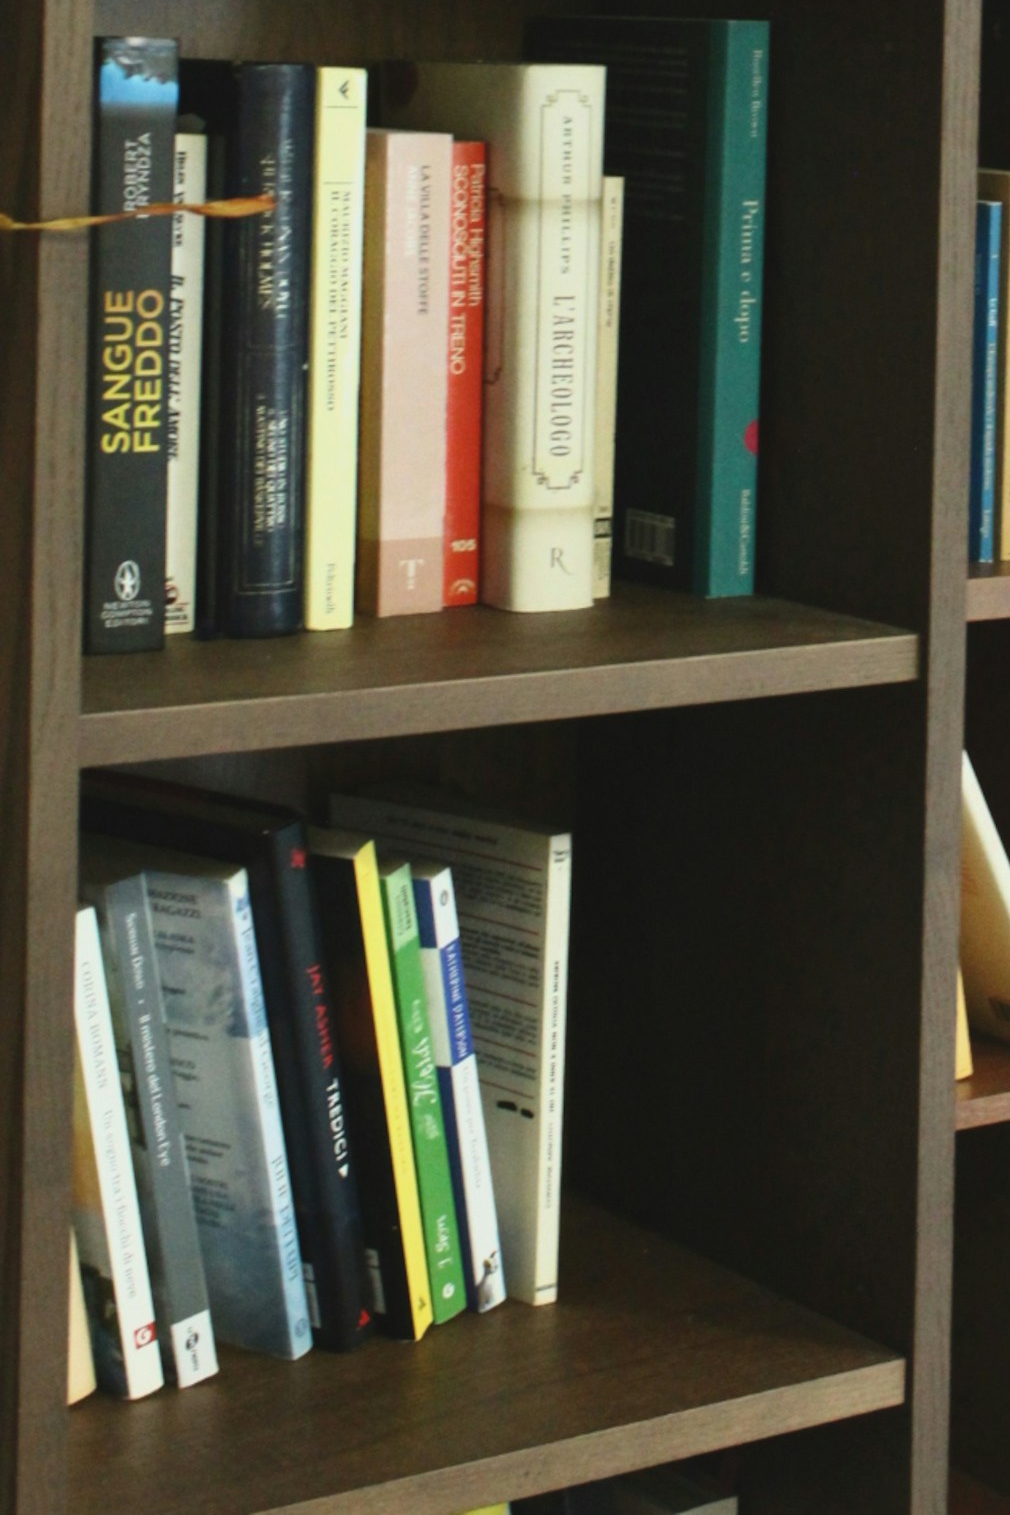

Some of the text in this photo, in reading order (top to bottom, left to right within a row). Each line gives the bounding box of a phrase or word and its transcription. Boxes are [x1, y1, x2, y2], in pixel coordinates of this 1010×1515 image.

[749, 99, 761, 138] Brown
[119, 139, 141, 210] ROBERT
[418, 185, 431, 221] VILLA
[558, 116, 575, 275] ARTHUR PHILLIPS
[328, 206, 341, 284] CORAGGIO
[338, 190, 353, 340] MAURIZIO MAGGIANI
[417, 223, 431, 264] DELLE
[464, 163, 486, 308] Patricia Highsmith
[738, 196, 761, 263] Prima
[327, 288, 338, 315] DEL
[416, 267, 431, 315] STOFFE
[447, 165, 474, 376] SCONOSCIUTI IN TRENO
[733, 288, 758, 343] dopo
[101, 290, 135, 454] SANGUE
[131, 289, 164, 454] FREDDO
[324, 319, 337, 412] PETTIROSSO
[547, 294, 578, 457] L'ARCHEOLOGO
[451, 538, 477, 552] 105
[78, 960, 109, 1089] CORINA BOMANN
[139, 1025, 158, 1073] mistero
[147, 1073, 162, 1096] del
[304, 962, 351, 1162] JAY ASHER TREDICI
[150, 1095, 169, 1141] London
[155, 1141, 173, 1168] Eye
[110, 1173, 123, 1195] tra
[123, 1267, 136, 1299] neve
